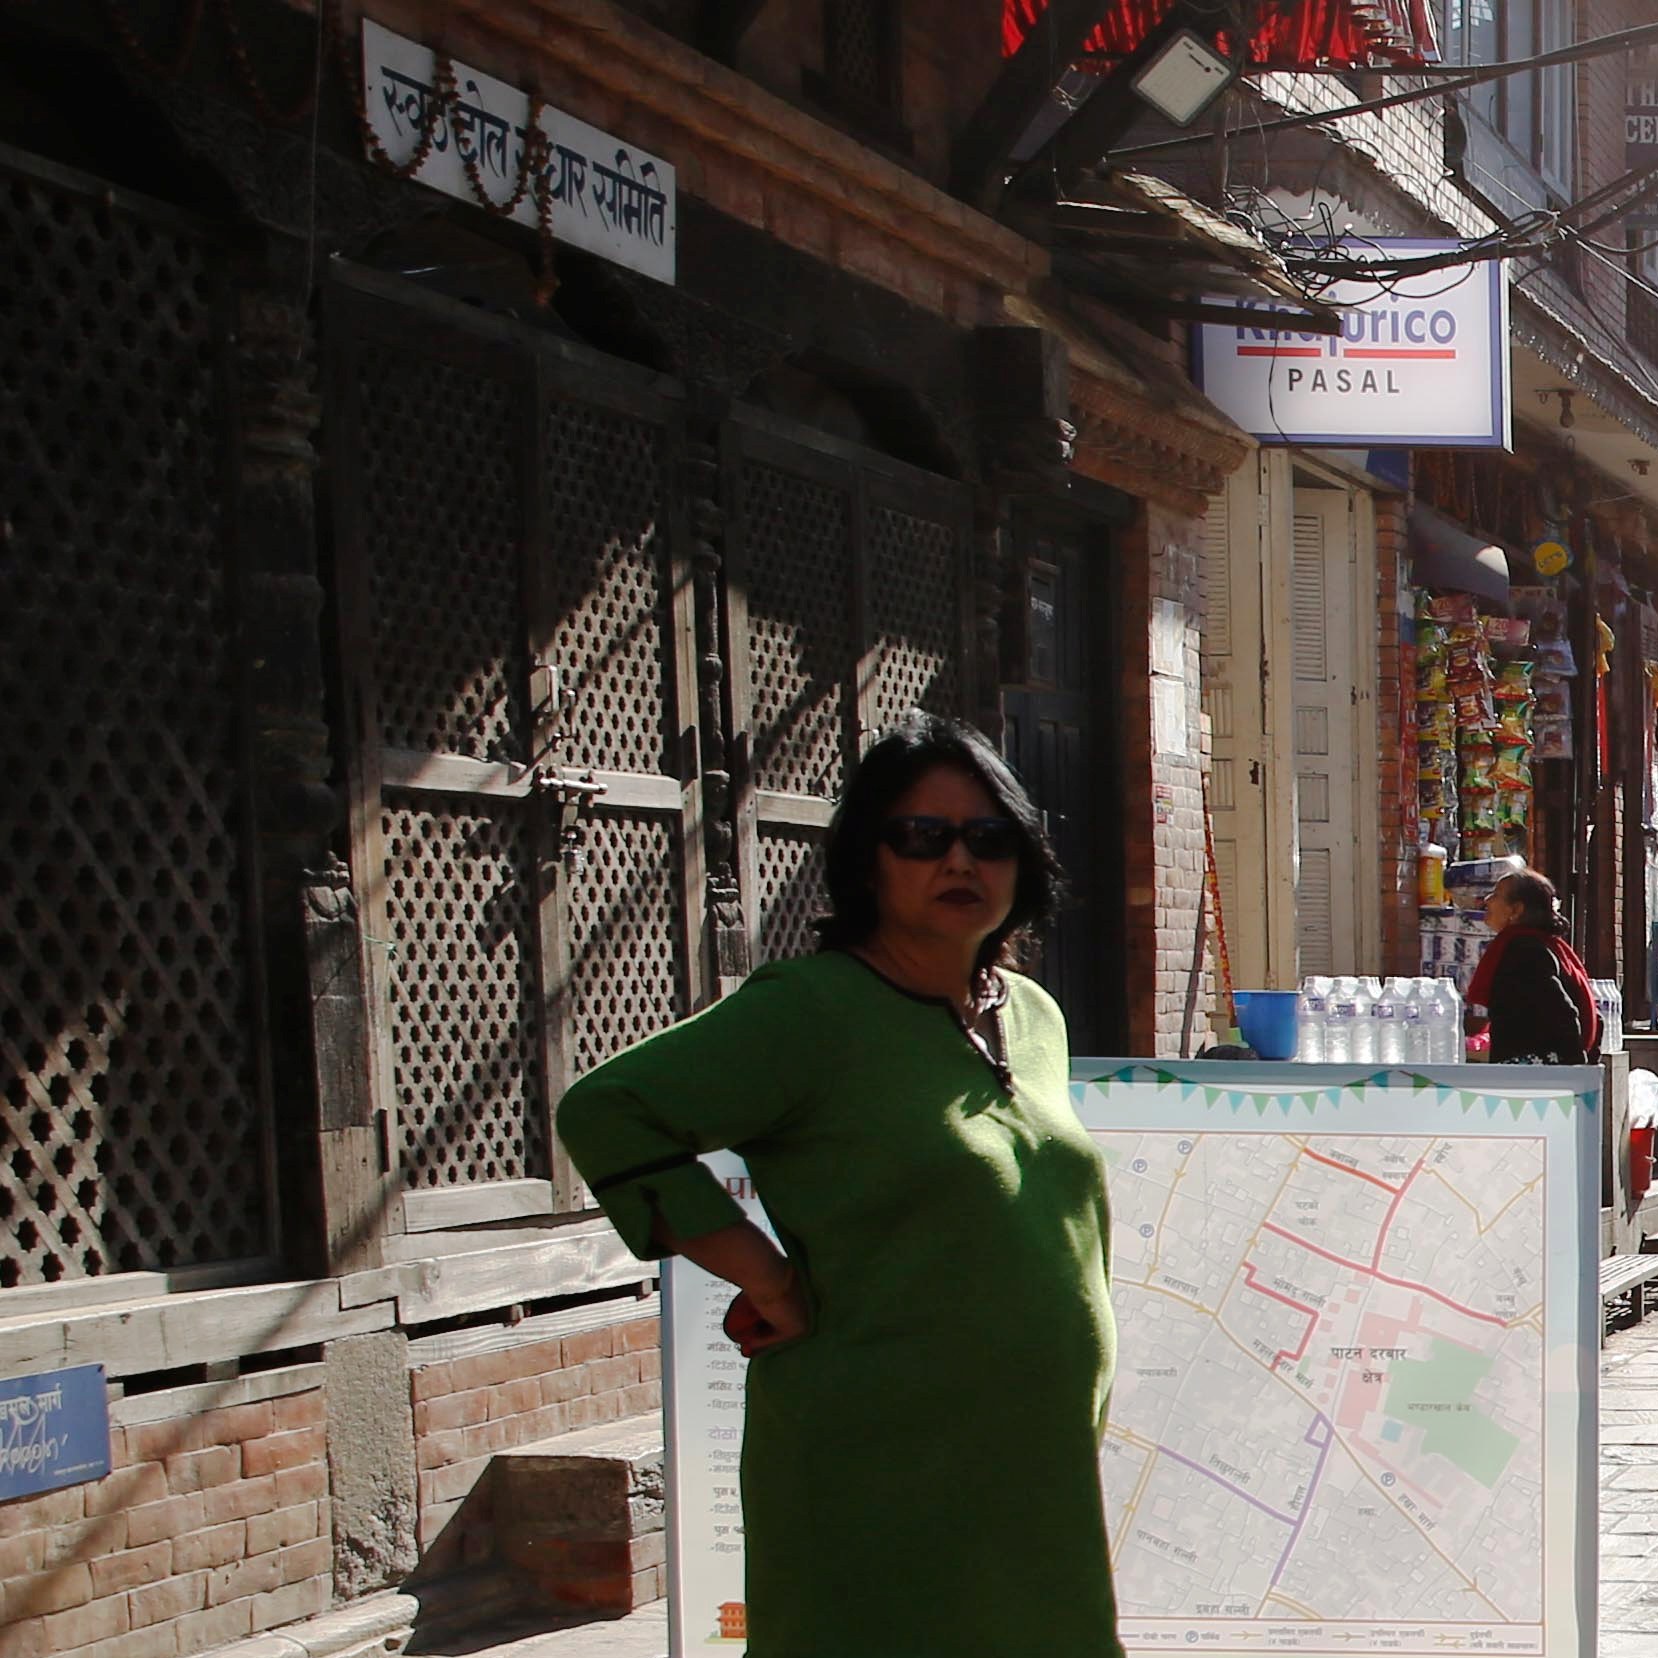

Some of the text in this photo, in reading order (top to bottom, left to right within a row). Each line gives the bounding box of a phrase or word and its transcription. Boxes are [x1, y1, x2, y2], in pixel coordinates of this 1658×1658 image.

[1288, 368, 1400, 393] PASAL
[1331, 1347, 1409, 1361] पाटन दरबार
[1362, 1368, 1384, 1385] क्षेत्र
